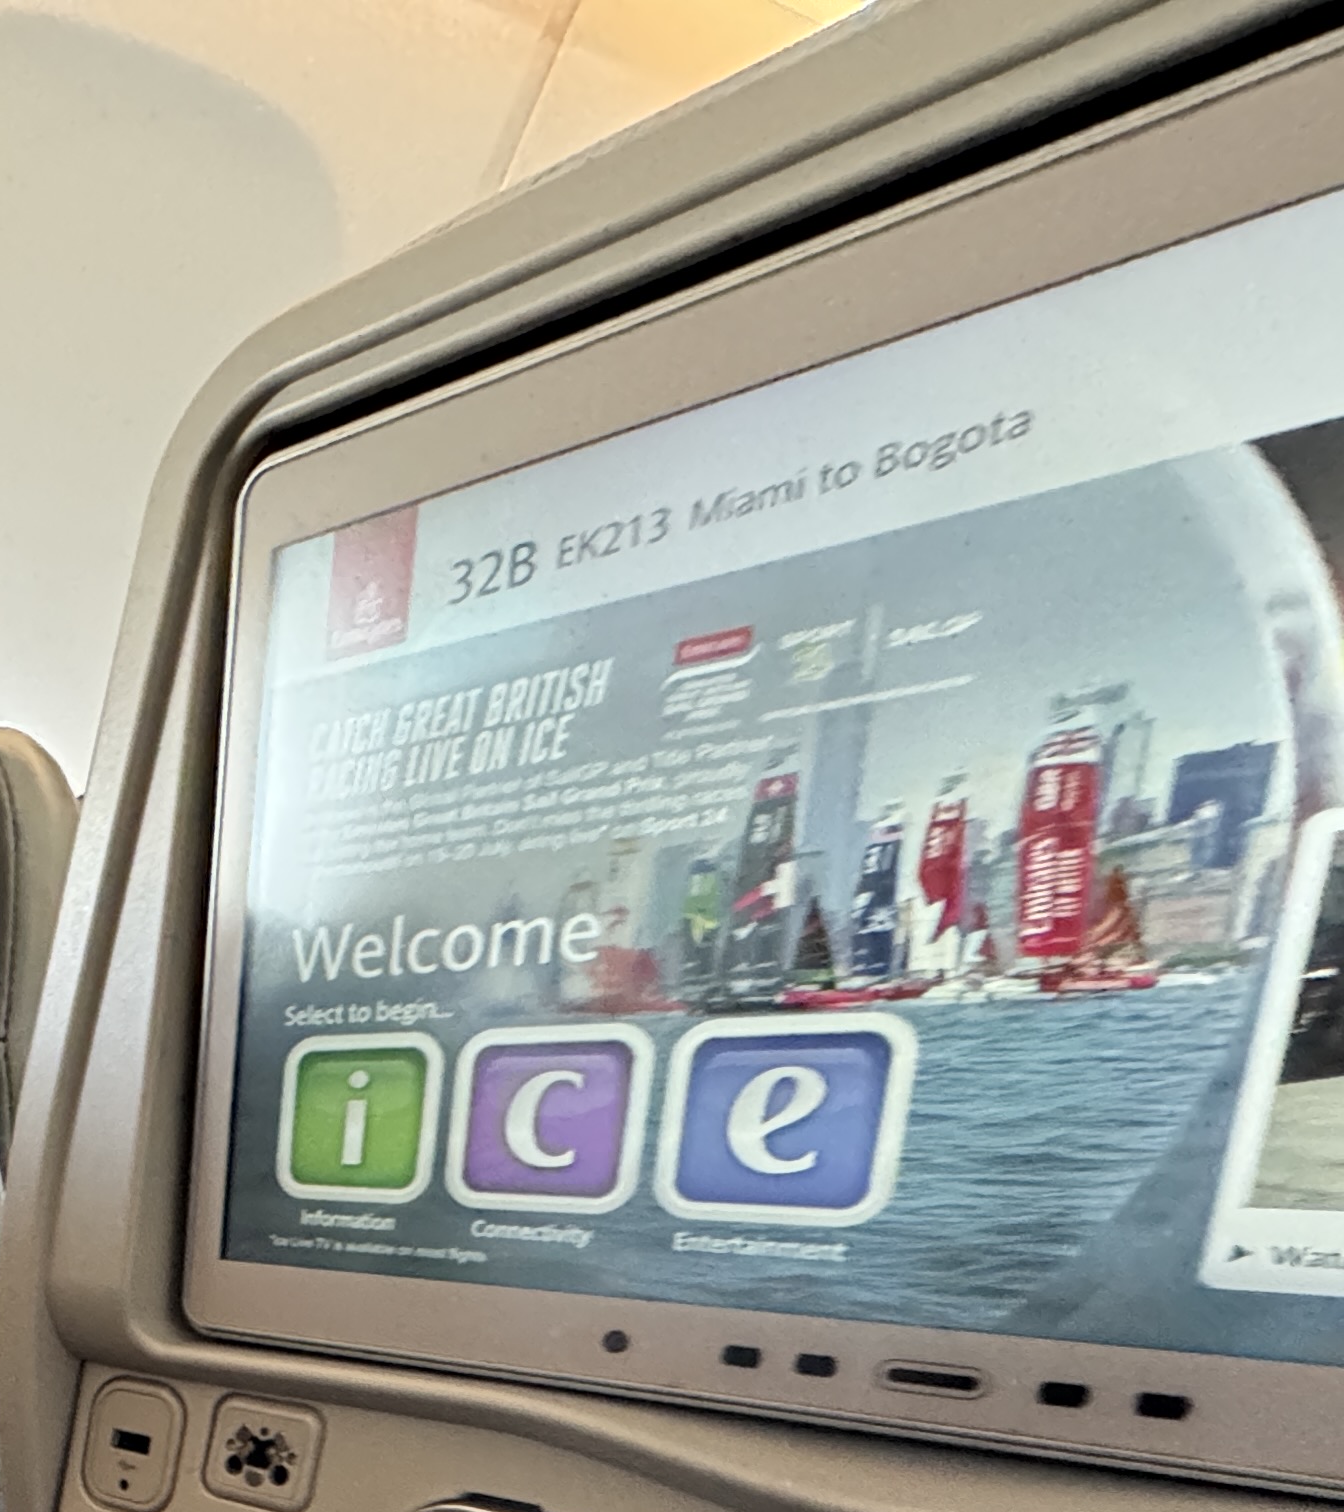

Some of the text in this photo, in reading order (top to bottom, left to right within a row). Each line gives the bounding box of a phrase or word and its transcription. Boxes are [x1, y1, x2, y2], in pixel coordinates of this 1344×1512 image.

[448, 409, 1035, 604] 32B EK213 Miami to Bogota
[392, 687, 484, 747] GREAT
[482, 657, 616, 728] BRITISH
[404, 735, 469, 787] LIVE
[468, 725, 515, 775] ON
[516, 713, 577, 768] ICE
[292, 913, 602, 983] Welcome
[284, 1004, 344, 1027] Select
[347, 1003, 373, 1024] to
[340, 1069, 369, 1166] i
[727, 1066, 828, 1175] e
[470, 1218, 595, 1249] Connectivity
